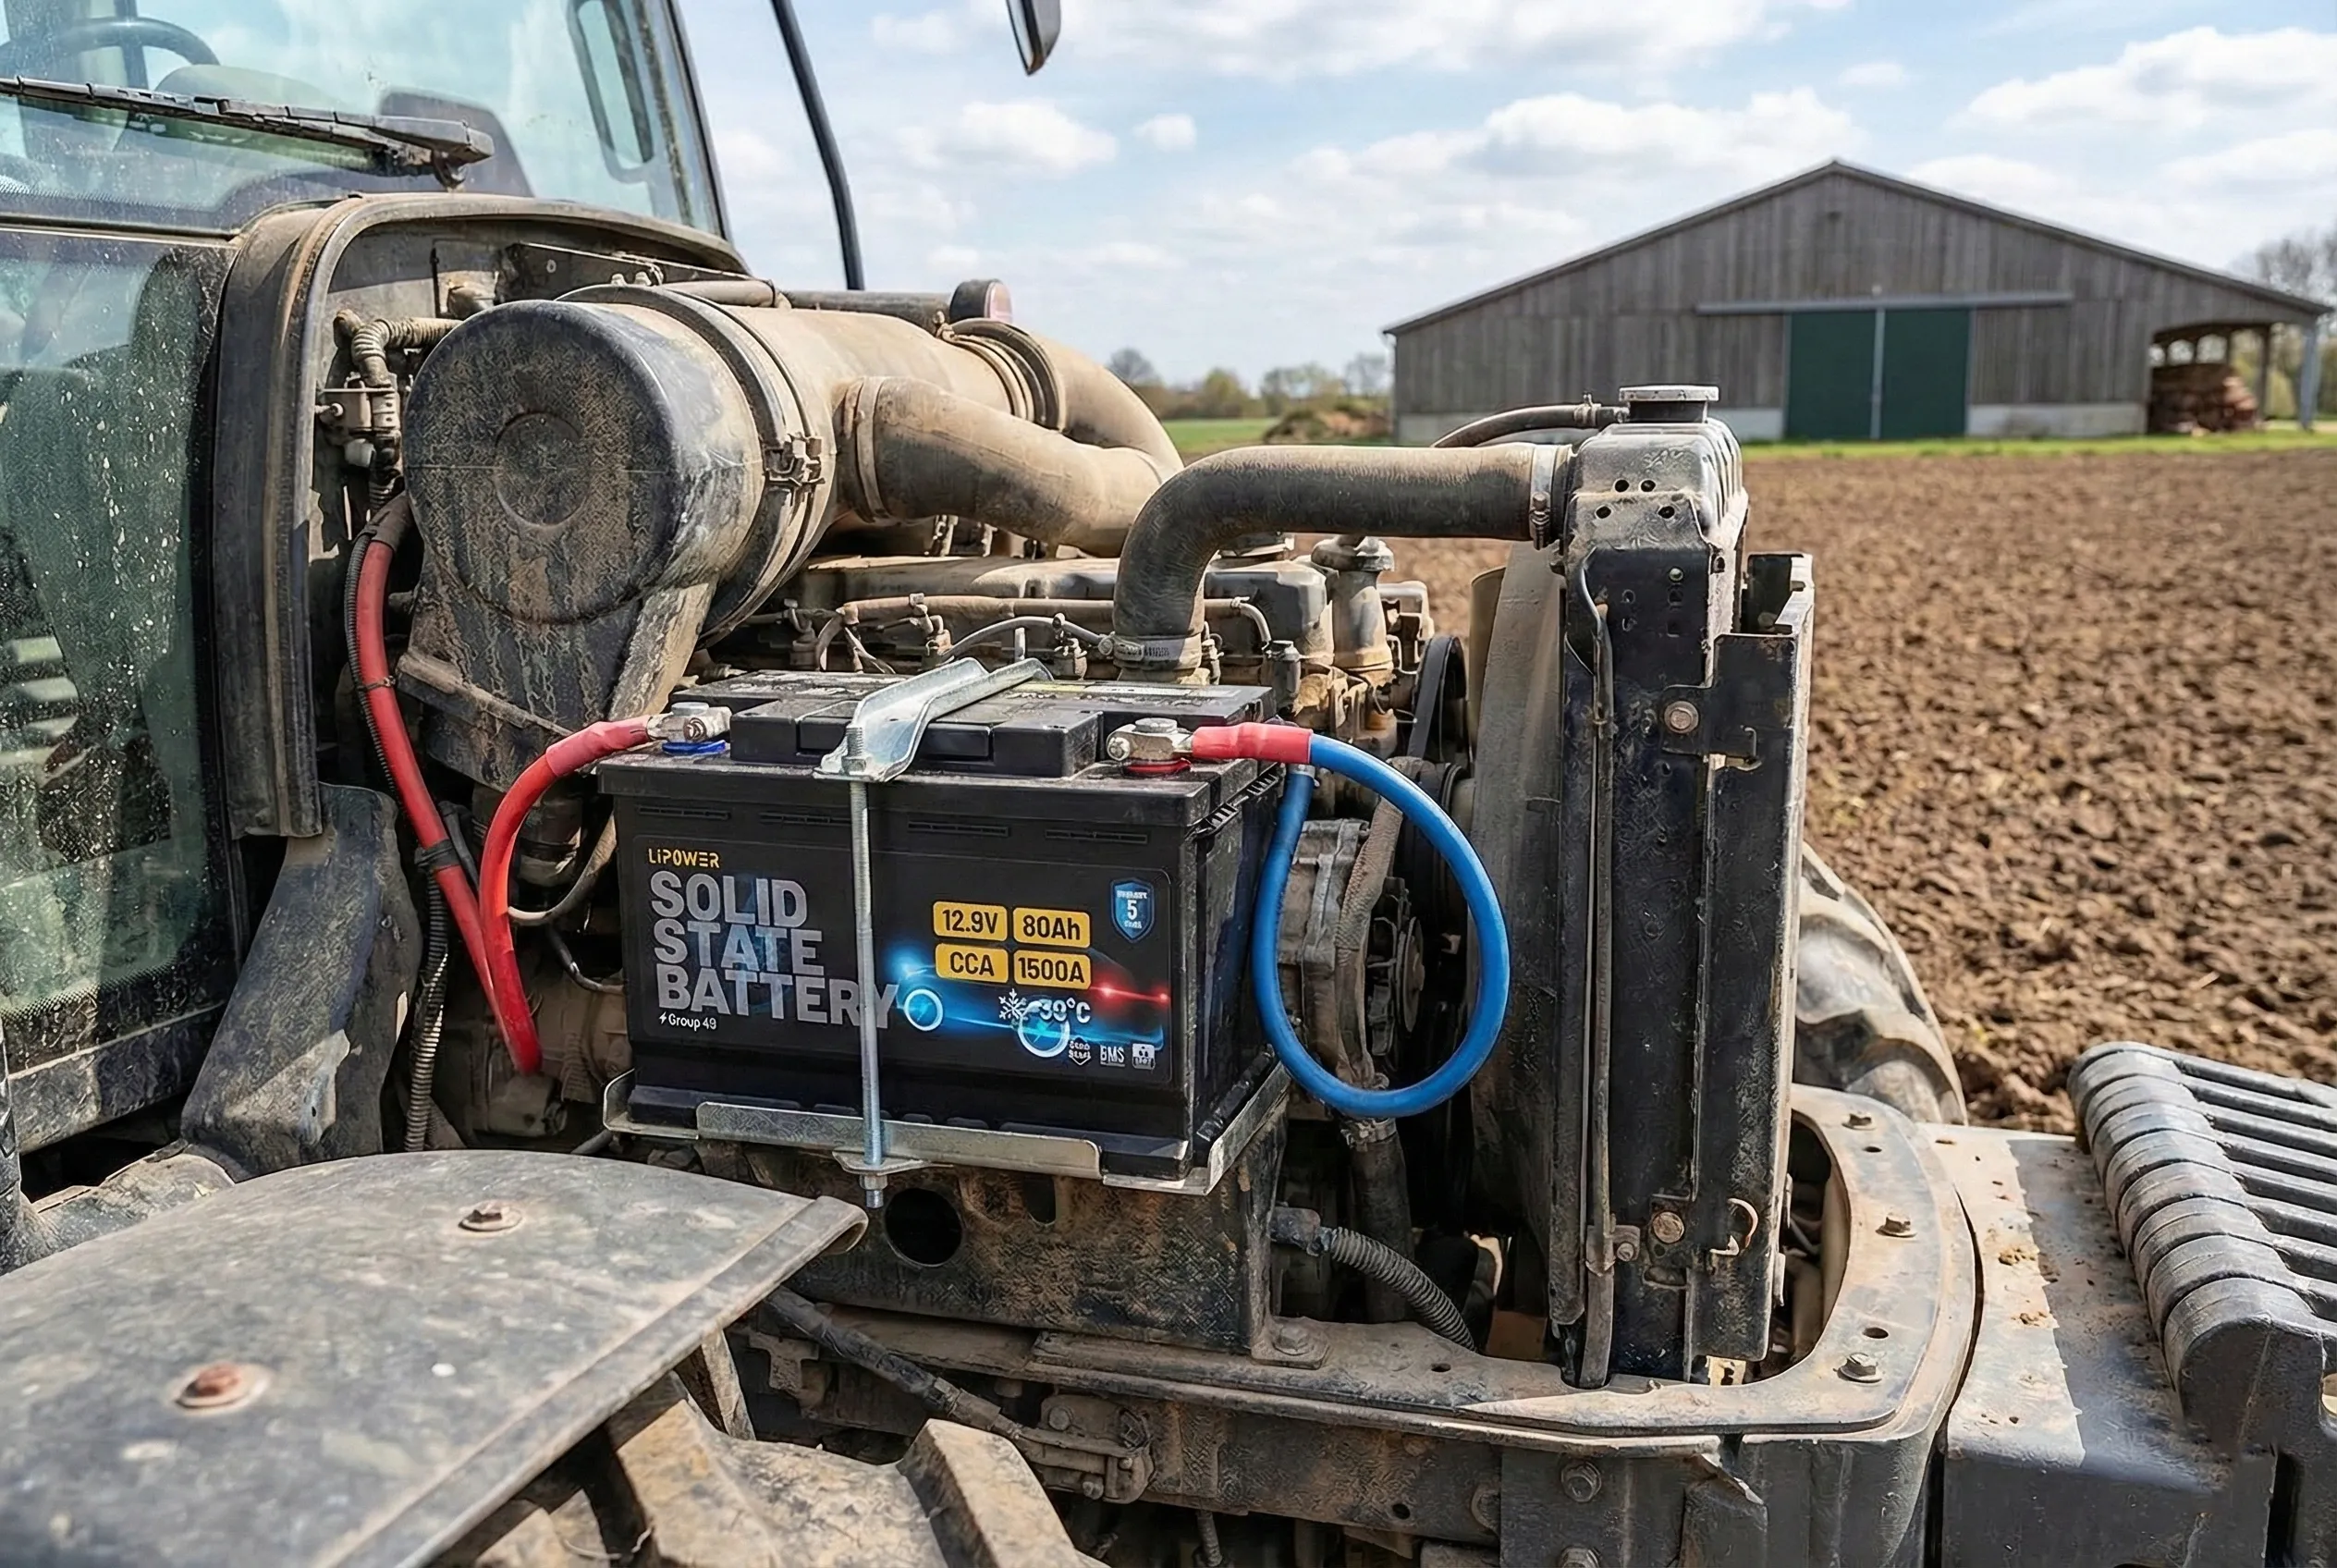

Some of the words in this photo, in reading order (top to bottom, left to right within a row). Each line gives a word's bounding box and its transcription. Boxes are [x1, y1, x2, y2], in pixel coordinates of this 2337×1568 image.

[651, 871, 808, 927] SOLID
[1127, 899, 1138, 921] 5
[942, 910, 998, 934] 12.9V
[1022, 914, 1081, 940] 80Ah
[654, 919, 825, 976] STATE
[949, 951, 995, 976] CCA
[1018, 957, 1085, 983] 1500A
[656, 963, 899, 1029] BATTERY
[668, 1013, 701, 1032] Group
[703, 1017, 717, 1030] 49
[1100, 1045, 1125, 1063] BMS
